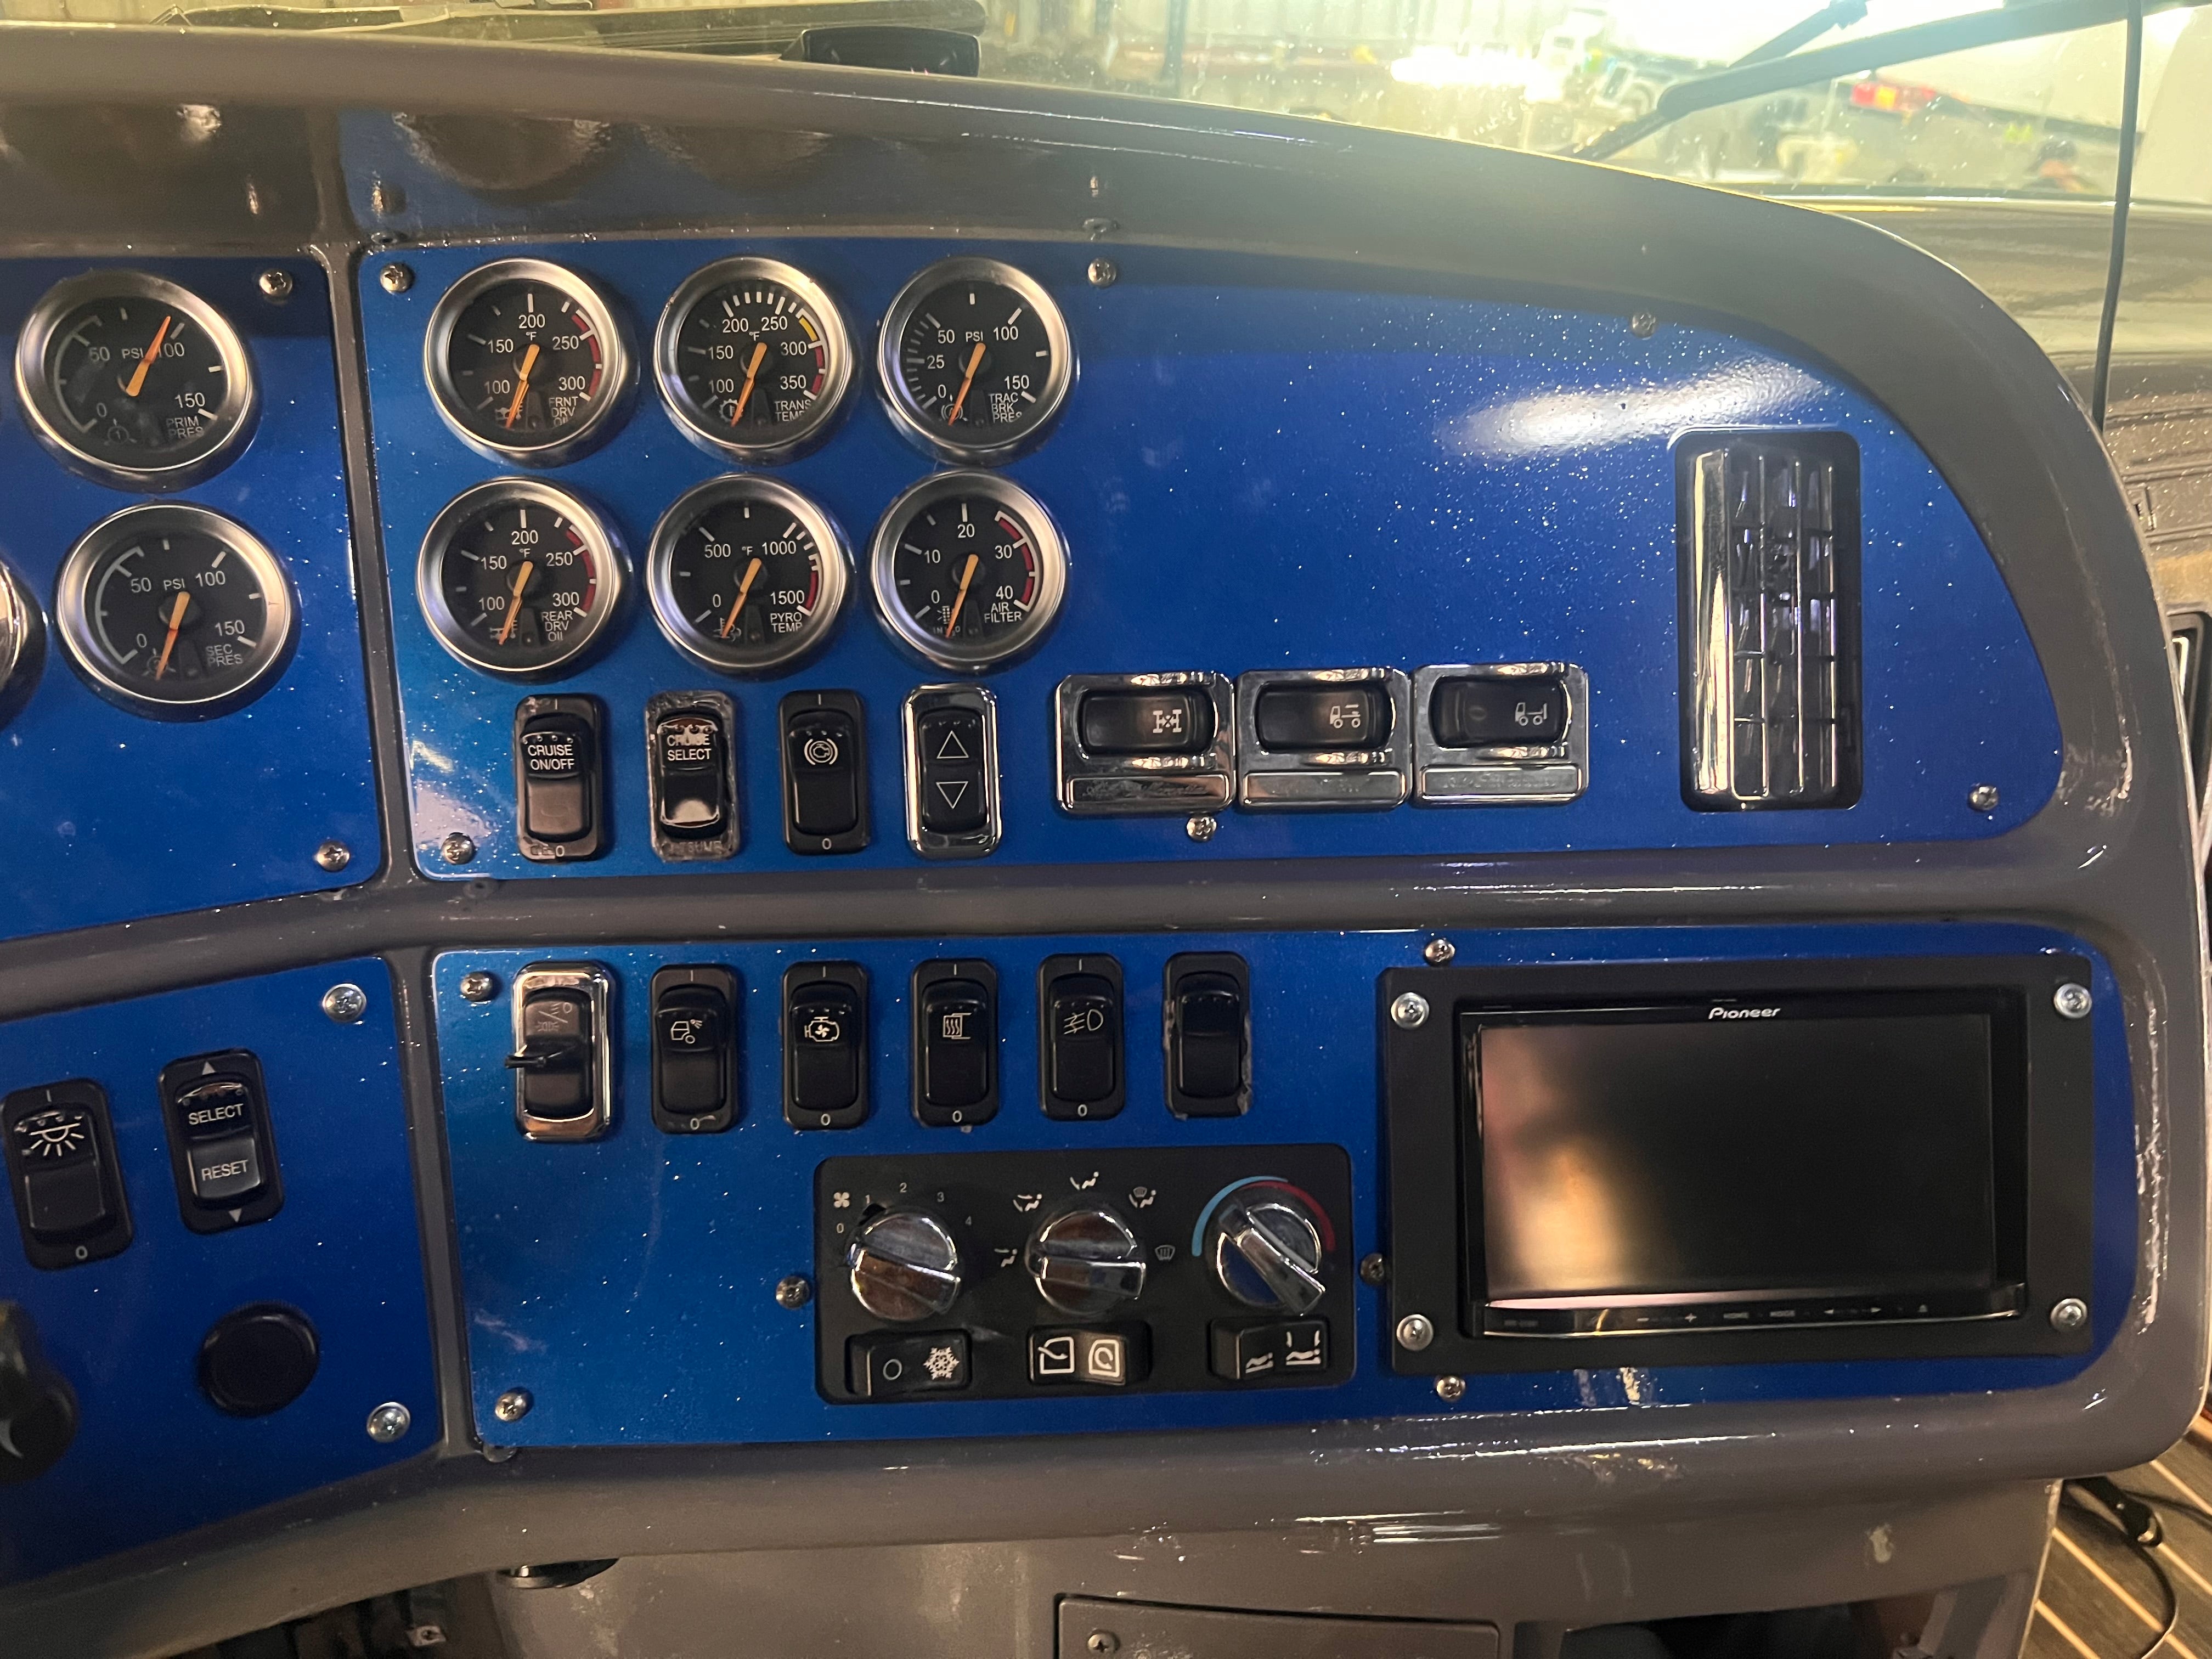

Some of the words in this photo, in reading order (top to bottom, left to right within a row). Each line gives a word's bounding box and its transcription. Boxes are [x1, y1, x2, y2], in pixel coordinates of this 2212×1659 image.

[518, 314, 545, 329] 200
[722, 317, 749, 333] 200
[761, 315, 788, 332] 250
[938, 329, 955, 344] 50
[966, 331, 984, 342] PSI
[993, 326, 1019, 341] 100
[487, 338, 514, 353] 150
[552, 335, 579, 351] 250
[780, 341, 807, 356] 300
[88, 347, 110, 362] 50
[121, 347, 144, 359] PSI
[708, 345, 733, 360] 150
[927, 354, 945, 369] 25
[484, 380, 510, 394] 100
[558, 376, 585, 391] 300
[709, 379, 734, 393] 100
[780, 375, 806, 390] 350
[1004, 375, 1030, 390] 150
[938, 384, 946, 399] 0
[988, 392, 1019, 404] TRAC
[174, 392, 206, 409] 150
[549, 396, 579, 408] FRNT
[774, 399, 811, 411] TRANS
[991, 402, 1015, 413] BRK
[96, 403, 108, 418] 0
[551, 407, 575, 417] DRV
[166, 415, 199, 428] PRIM
[511, 529, 539, 545] 200
[957, 523, 975, 539] 20
[704, 543, 731, 558] 500
[762, 540, 797, 556] 1000
[994, 545, 1012, 560] 30
[480, 555, 507, 571] 150
[545, 552, 573, 567] 250
[924, 549, 941, 564] 10
[131, 577, 152, 594] 50
[163, 578, 185, 591] PSI
[195, 571, 225, 588] 100
[552, 591, 579, 607] 300
[770, 590, 805, 605] 1500
[931, 589, 940, 604] 0
[995, 585, 1013, 600] 40
[478, 596, 505, 611] 100
[712, 594, 721, 608] 0
[991, 601, 1009, 613] AIR
[541, 610, 573, 622] REAR
[770, 612, 802, 623] PYRO
[984, 611, 1022, 624] FILTER
[215, 620, 245, 637] 150
[545, 620, 569, 631] DRV
[771, 622, 803, 633] TEMP
[137, 633, 147, 648] 0
[206, 644, 233, 656] SEC
[207, 653, 243, 667] PRES
[527, 744, 574, 757] CRUISE
[667, 748, 712, 761] SELECT
[530, 758, 575, 771] ON/OFF
[1708, 1007, 1782, 1020] Pioneer
[188, 1103, 244, 1126] SELECT
[201, 1160, 249, 1181] RESET
[900, 1182, 907, 1193] 2
[864, 1194, 871, 1205] 1
[936, 1192, 945, 1203] 3
[836, 1223, 844, 1234] 0
[964, 1216, 973, 1226] 4
